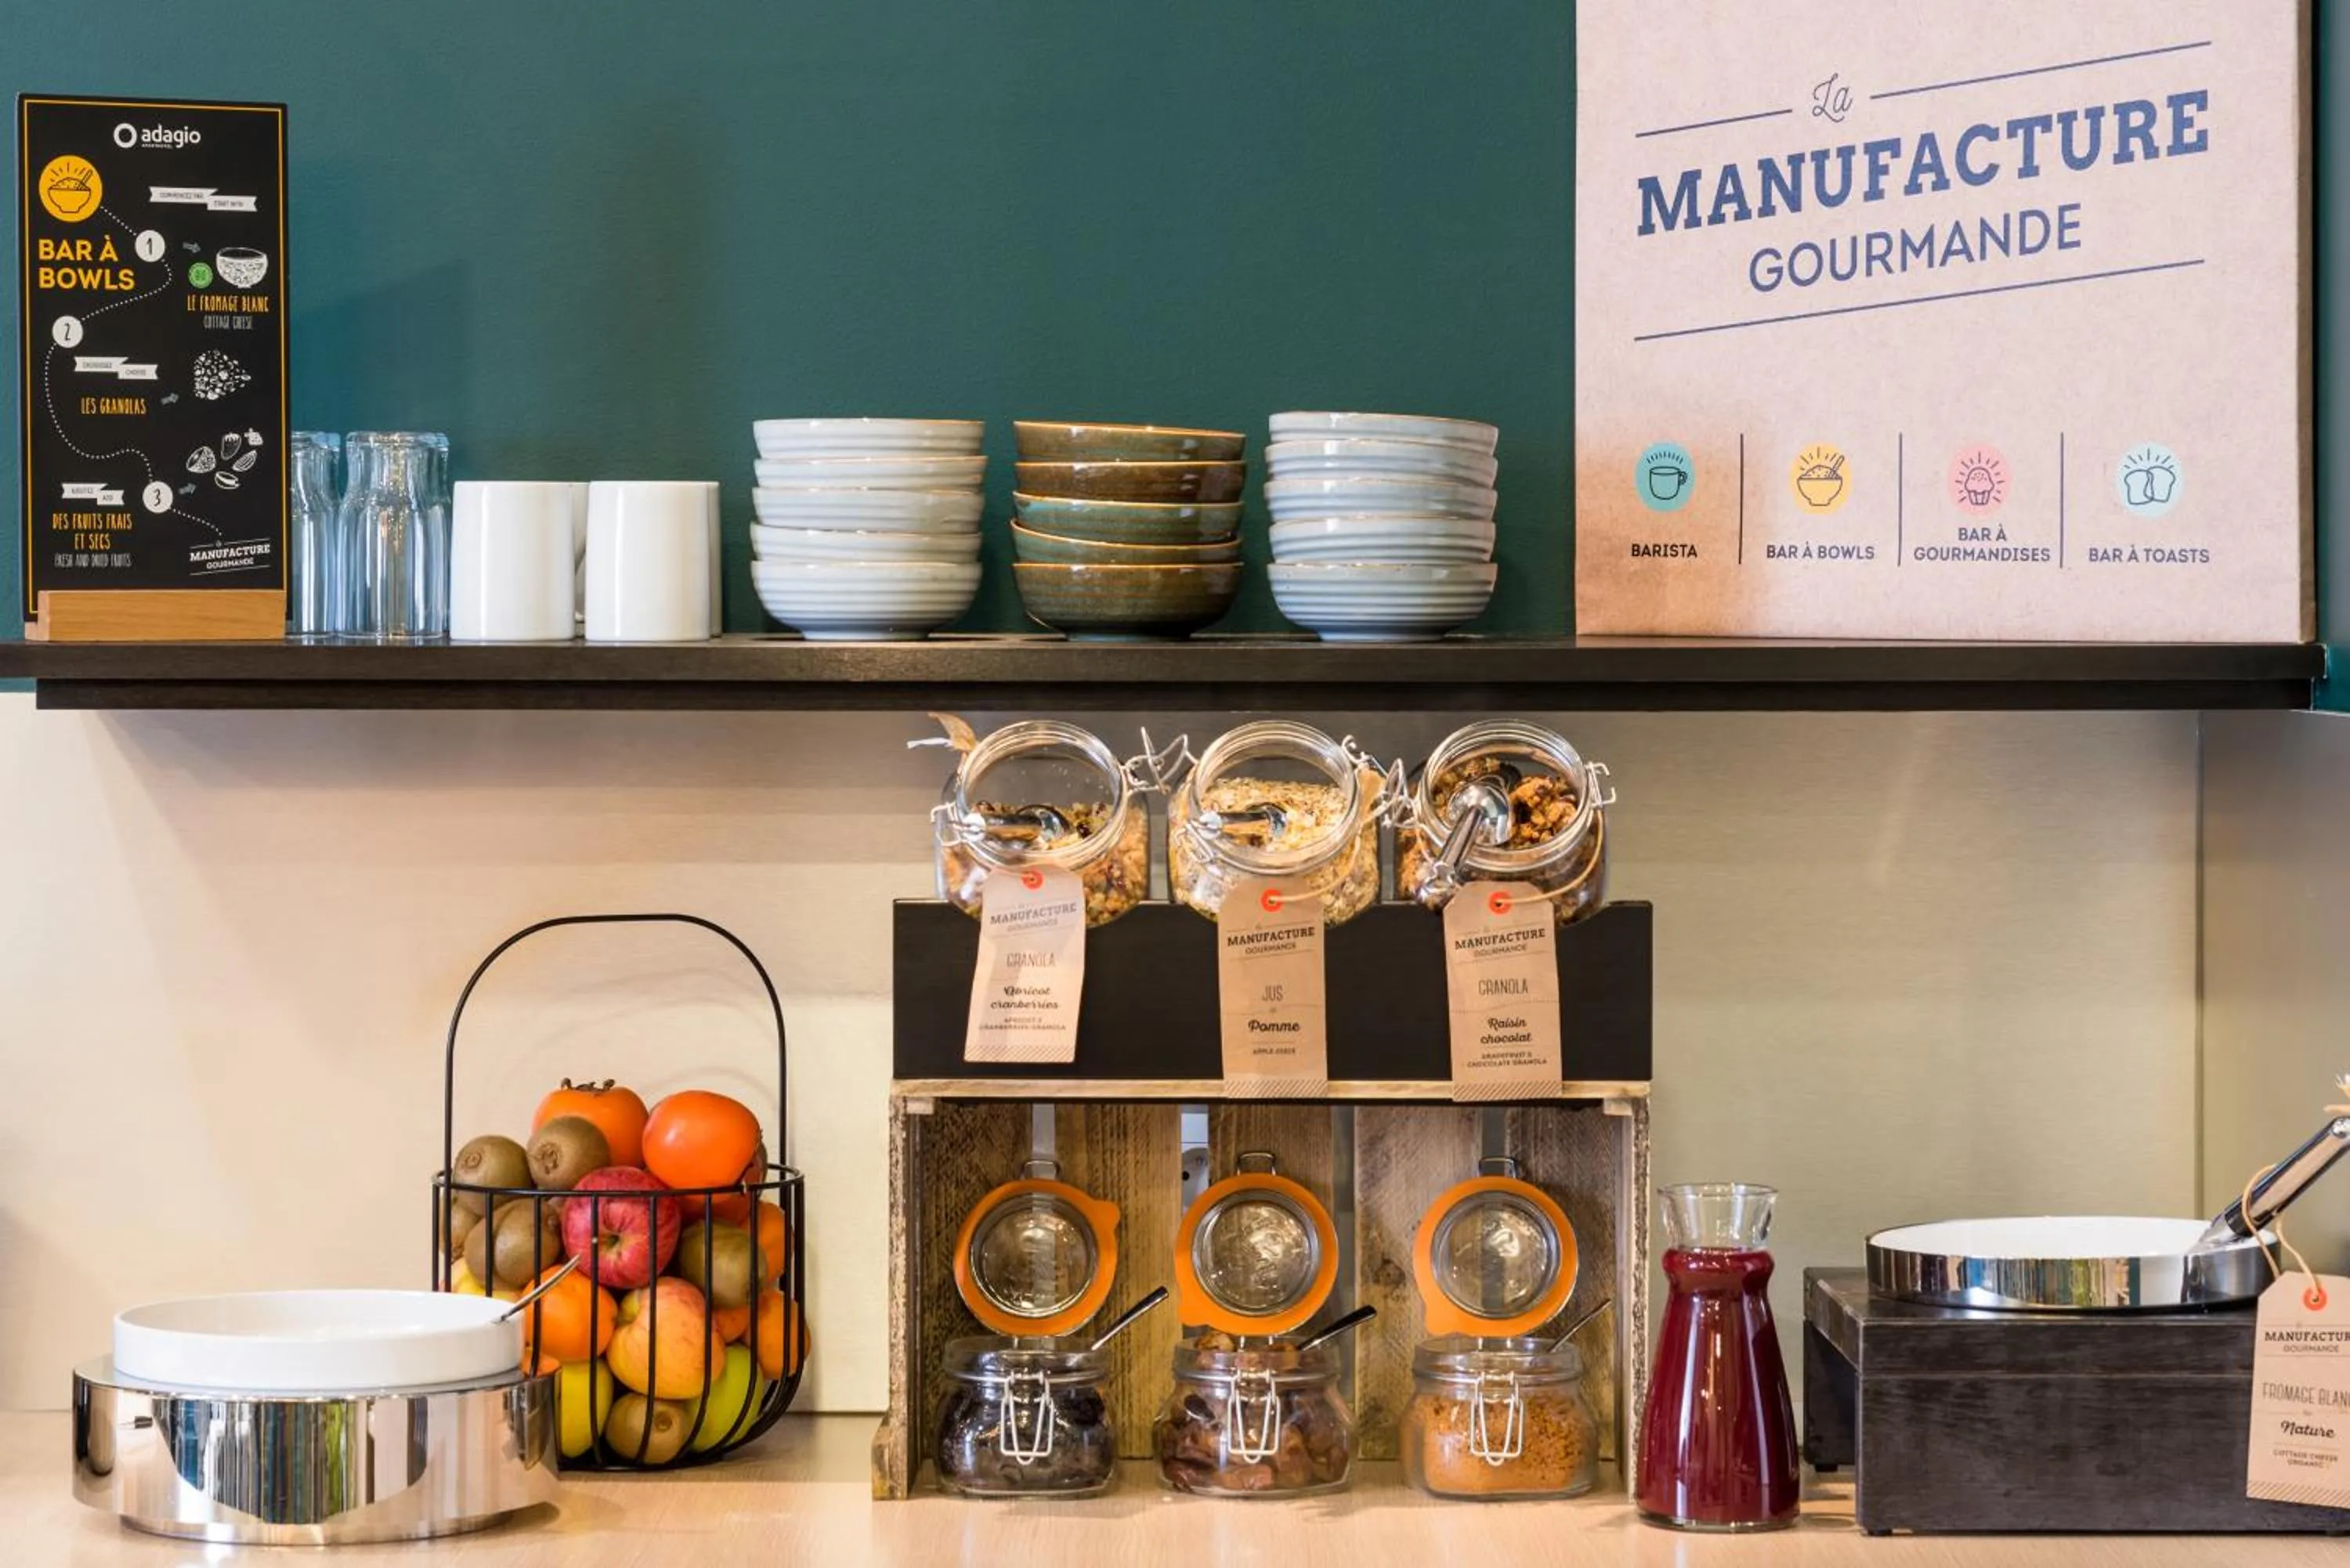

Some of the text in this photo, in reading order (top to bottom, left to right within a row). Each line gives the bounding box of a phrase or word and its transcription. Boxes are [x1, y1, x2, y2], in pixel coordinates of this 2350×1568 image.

[1811, 73, 1853, 124] La
[141, 123, 201, 149] adagio
[1636, 89, 2210, 237] MANUFACTURE
[38, 234, 118, 262] BAR À
[146, 237, 154, 256] 1
[1748, 202, 2082, 294] GOURMANDE
[38, 268, 136, 291] BOWLS
[187, 294, 269, 313] LE FROMAGE BLANC
[63, 323, 71, 341] 2
[81, 397, 147, 414] LES GRANOLAS
[154, 488, 161, 507] 3
[52, 513, 132, 530] DES FRUITS FRAIS
[1958, 523, 2008, 542] BAR À
[74, 534, 110, 551] ET SECS
[1630, 544, 1698, 558] BARISTA
[1766, 540, 1876, 560] BAR À BOWLS
[190, 544, 271, 562] MANUFACTURE
[1913, 546, 2051, 562] GOURMANDISES
[2088, 544, 2211, 564] BAR À TOASTS
[989, 901, 1078, 925] MANUFACTURE
[1227, 927, 1316, 947] MANUFACTURE
[1454, 928, 1546, 950] MANUFACTURE
[1007, 952, 1056, 968] GRANOLA
[1261, 985, 1284, 1002] JUS
[1478, 978, 1528, 995] GRANOLA
[1248, 1019, 1301, 1032] Pomme
[1488, 1017, 1528, 1031] Raisin
[1480, 1032, 1533, 1044] chocolat
[2262, 1382, 2350, 1407] FROMAGE BLAN
[2280, 1420, 2336, 1439] Nature
